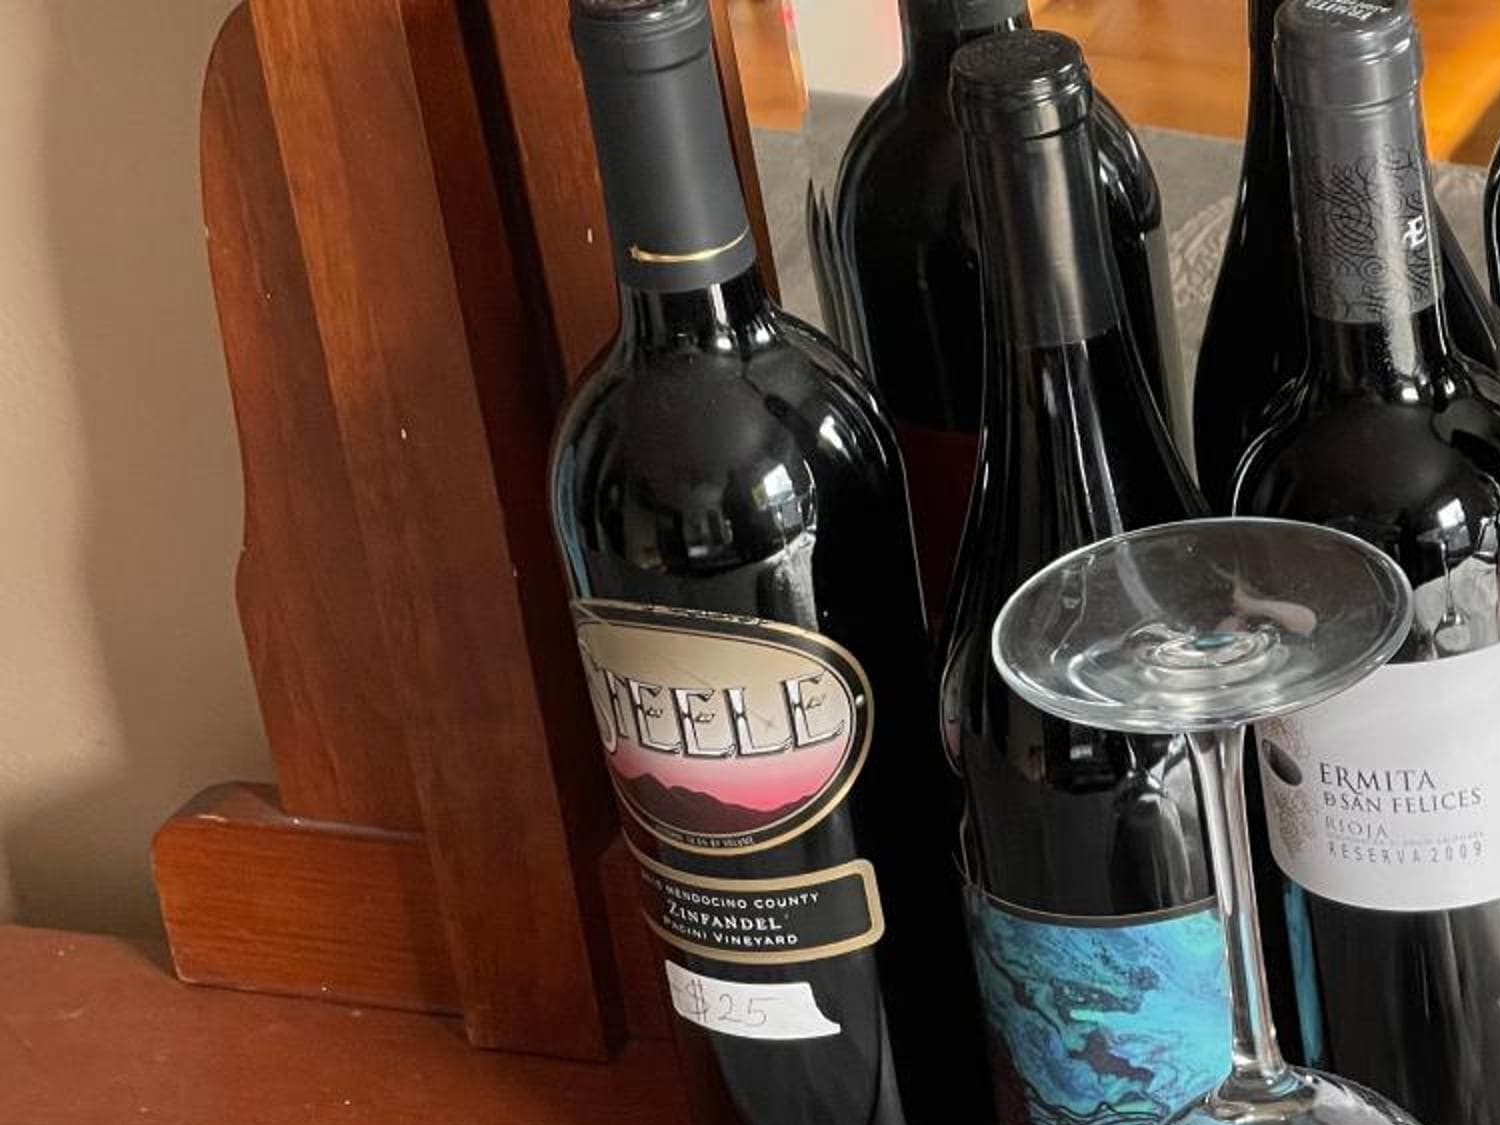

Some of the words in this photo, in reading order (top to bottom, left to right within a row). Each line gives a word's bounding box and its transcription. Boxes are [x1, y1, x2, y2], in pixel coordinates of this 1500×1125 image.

[1320, 763, 1437, 795] ERMITA
[1391, 788, 1482, 814] FELICES
[1325, 816, 1389, 839] RIOJA
[1328, 841, 1421, 864] RESERVA
[1430, 840, 1483, 863] 2009
[665, 884, 748, 909] MENDOCINO
[753, 892, 820, 909] COUNTY
[667, 900, 783, 931] ZINFANDEL
[713, 932, 799, 946] VINEYARD
